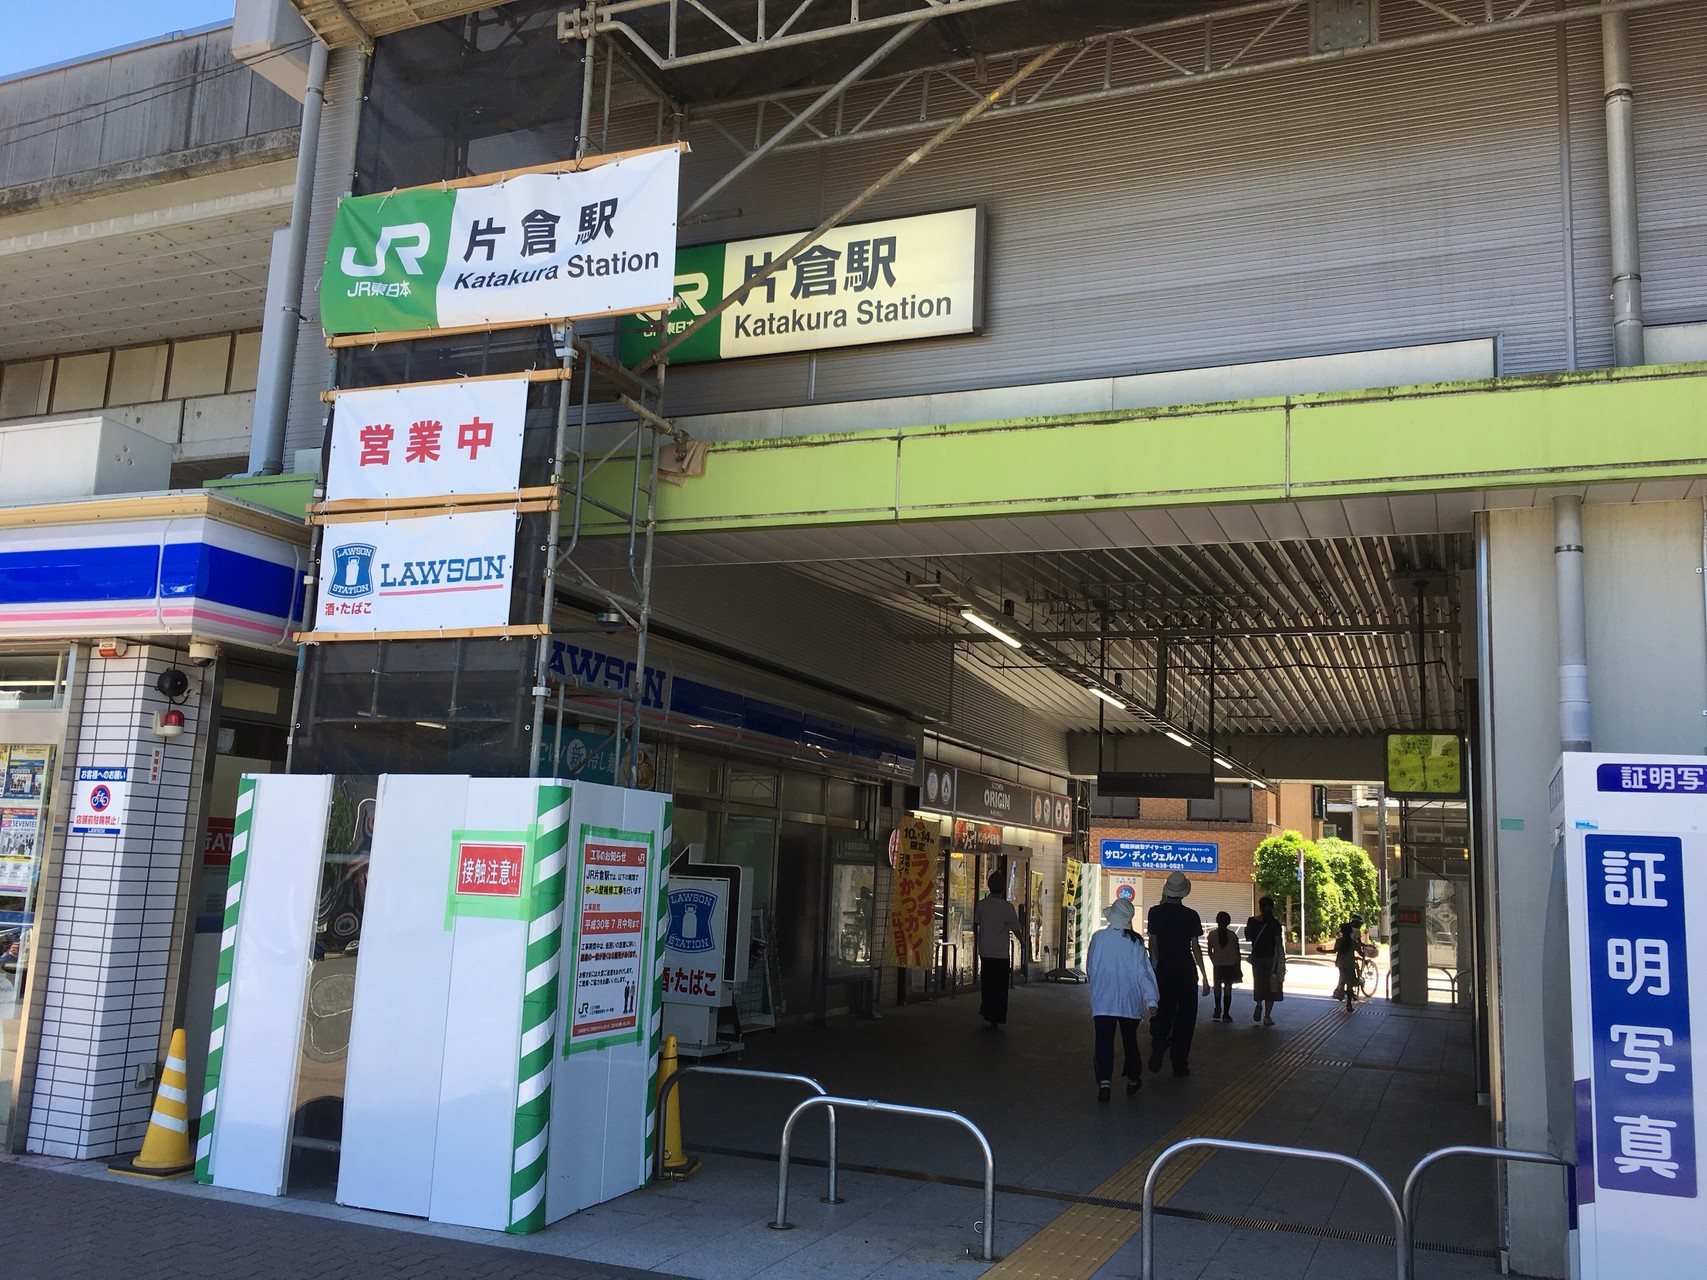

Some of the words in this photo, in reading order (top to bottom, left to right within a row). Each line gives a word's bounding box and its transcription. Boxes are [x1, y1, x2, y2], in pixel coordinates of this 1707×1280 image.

[463, 197, 619, 263] 片倉駅
[340, 221, 431, 277] JR
[453, 264, 559, 291] Katakura
[567, 249, 660, 279] Station
[737, 235, 897, 307] 片倉駅
[346, 279, 412, 299] JR東日本
[734, 308, 857, 339] Katakura
[856, 295, 952, 326] Station
[359, 416, 494, 467] 営業中
[336, 546, 372, 558] LAWSON
[380, 554, 506, 588] LAWSON
[331, 582, 370, 595] STATION
[324, 602, 372, 616] 酒・たばこ
[80, 769, 126, 780] お客様へのお願い
[1620, 766, 1707, 791] 証明写
[983, 788, 1011, 811] ORIGIN
[12, 819, 37, 828] SEVENTE
[590, 849, 627, 862] 工事のお知らせ
[461, 858, 518, 886] 接触注意!!
[670, 893, 713, 907] LAWSON
[668, 935, 709, 950] STATION
[1602, 850, 1678, 1180] 証明写真
